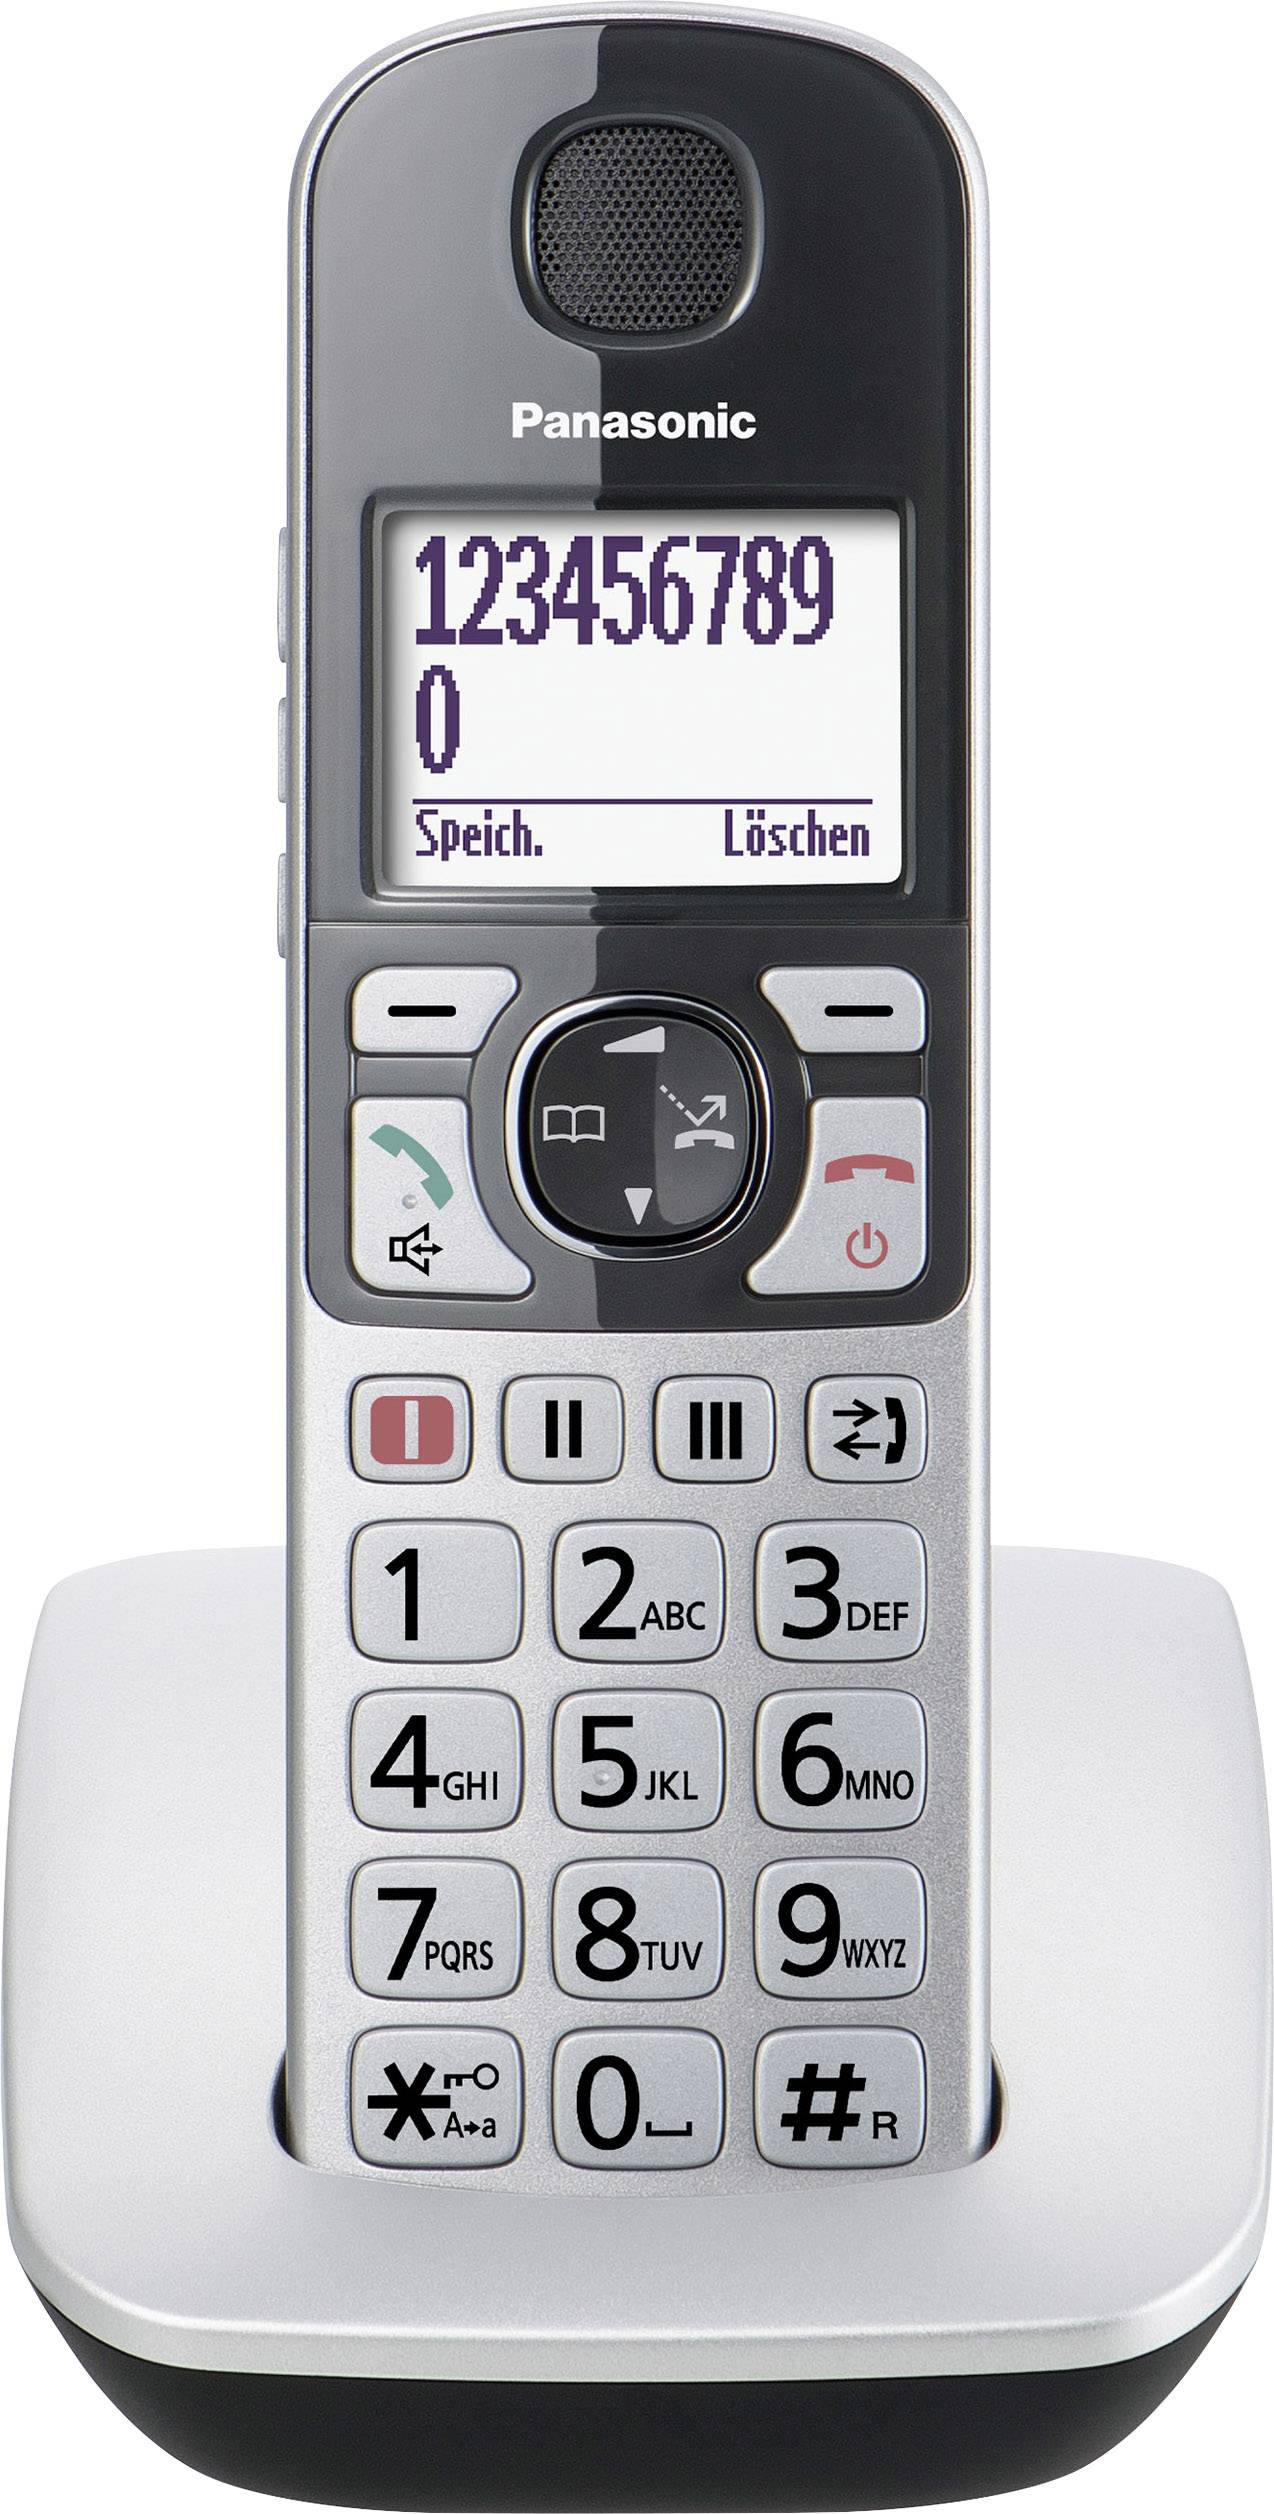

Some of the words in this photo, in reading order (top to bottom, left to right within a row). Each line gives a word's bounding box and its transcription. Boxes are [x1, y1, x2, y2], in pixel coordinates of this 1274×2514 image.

[512, 401, 756, 439] Panasonic
[415, 535, 834, 645] 123456789
[415, 664, 460, 774] 0
[415, 808, 543, 862] Speich.
[724, 808, 870, 857] Löschen
[384, 1548, 419, 1641] 1
[578, 1546, 637, 1640] 2
[639, 1601, 706, 1631] ABC
[782, 1545, 842, 1641] 3
[847, 1601, 909, 1632] DEF
[370, 1714, 440, 1809] 4
[443, 1771, 498, 1801] GHI
[580, 1715, 638, 1809] 5
[644, 1770, 699, 1801] JKL
[781, 1711, 844, 1807] 6
[845, 1769, 915, 1801] MNO
[377, 1887, 437, 1981] 7
[425, 1940, 494, 1974] PQRS
[575, 1886, 640, 1982] 8
[640, 1941, 704, 1971] TUV
[777, 1882, 841, 1978] 9
[842, 1938, 907, 1969] WXYZ
[576, 2054, 640, 2151] 0
[872, 2111, 899, 2140] R
